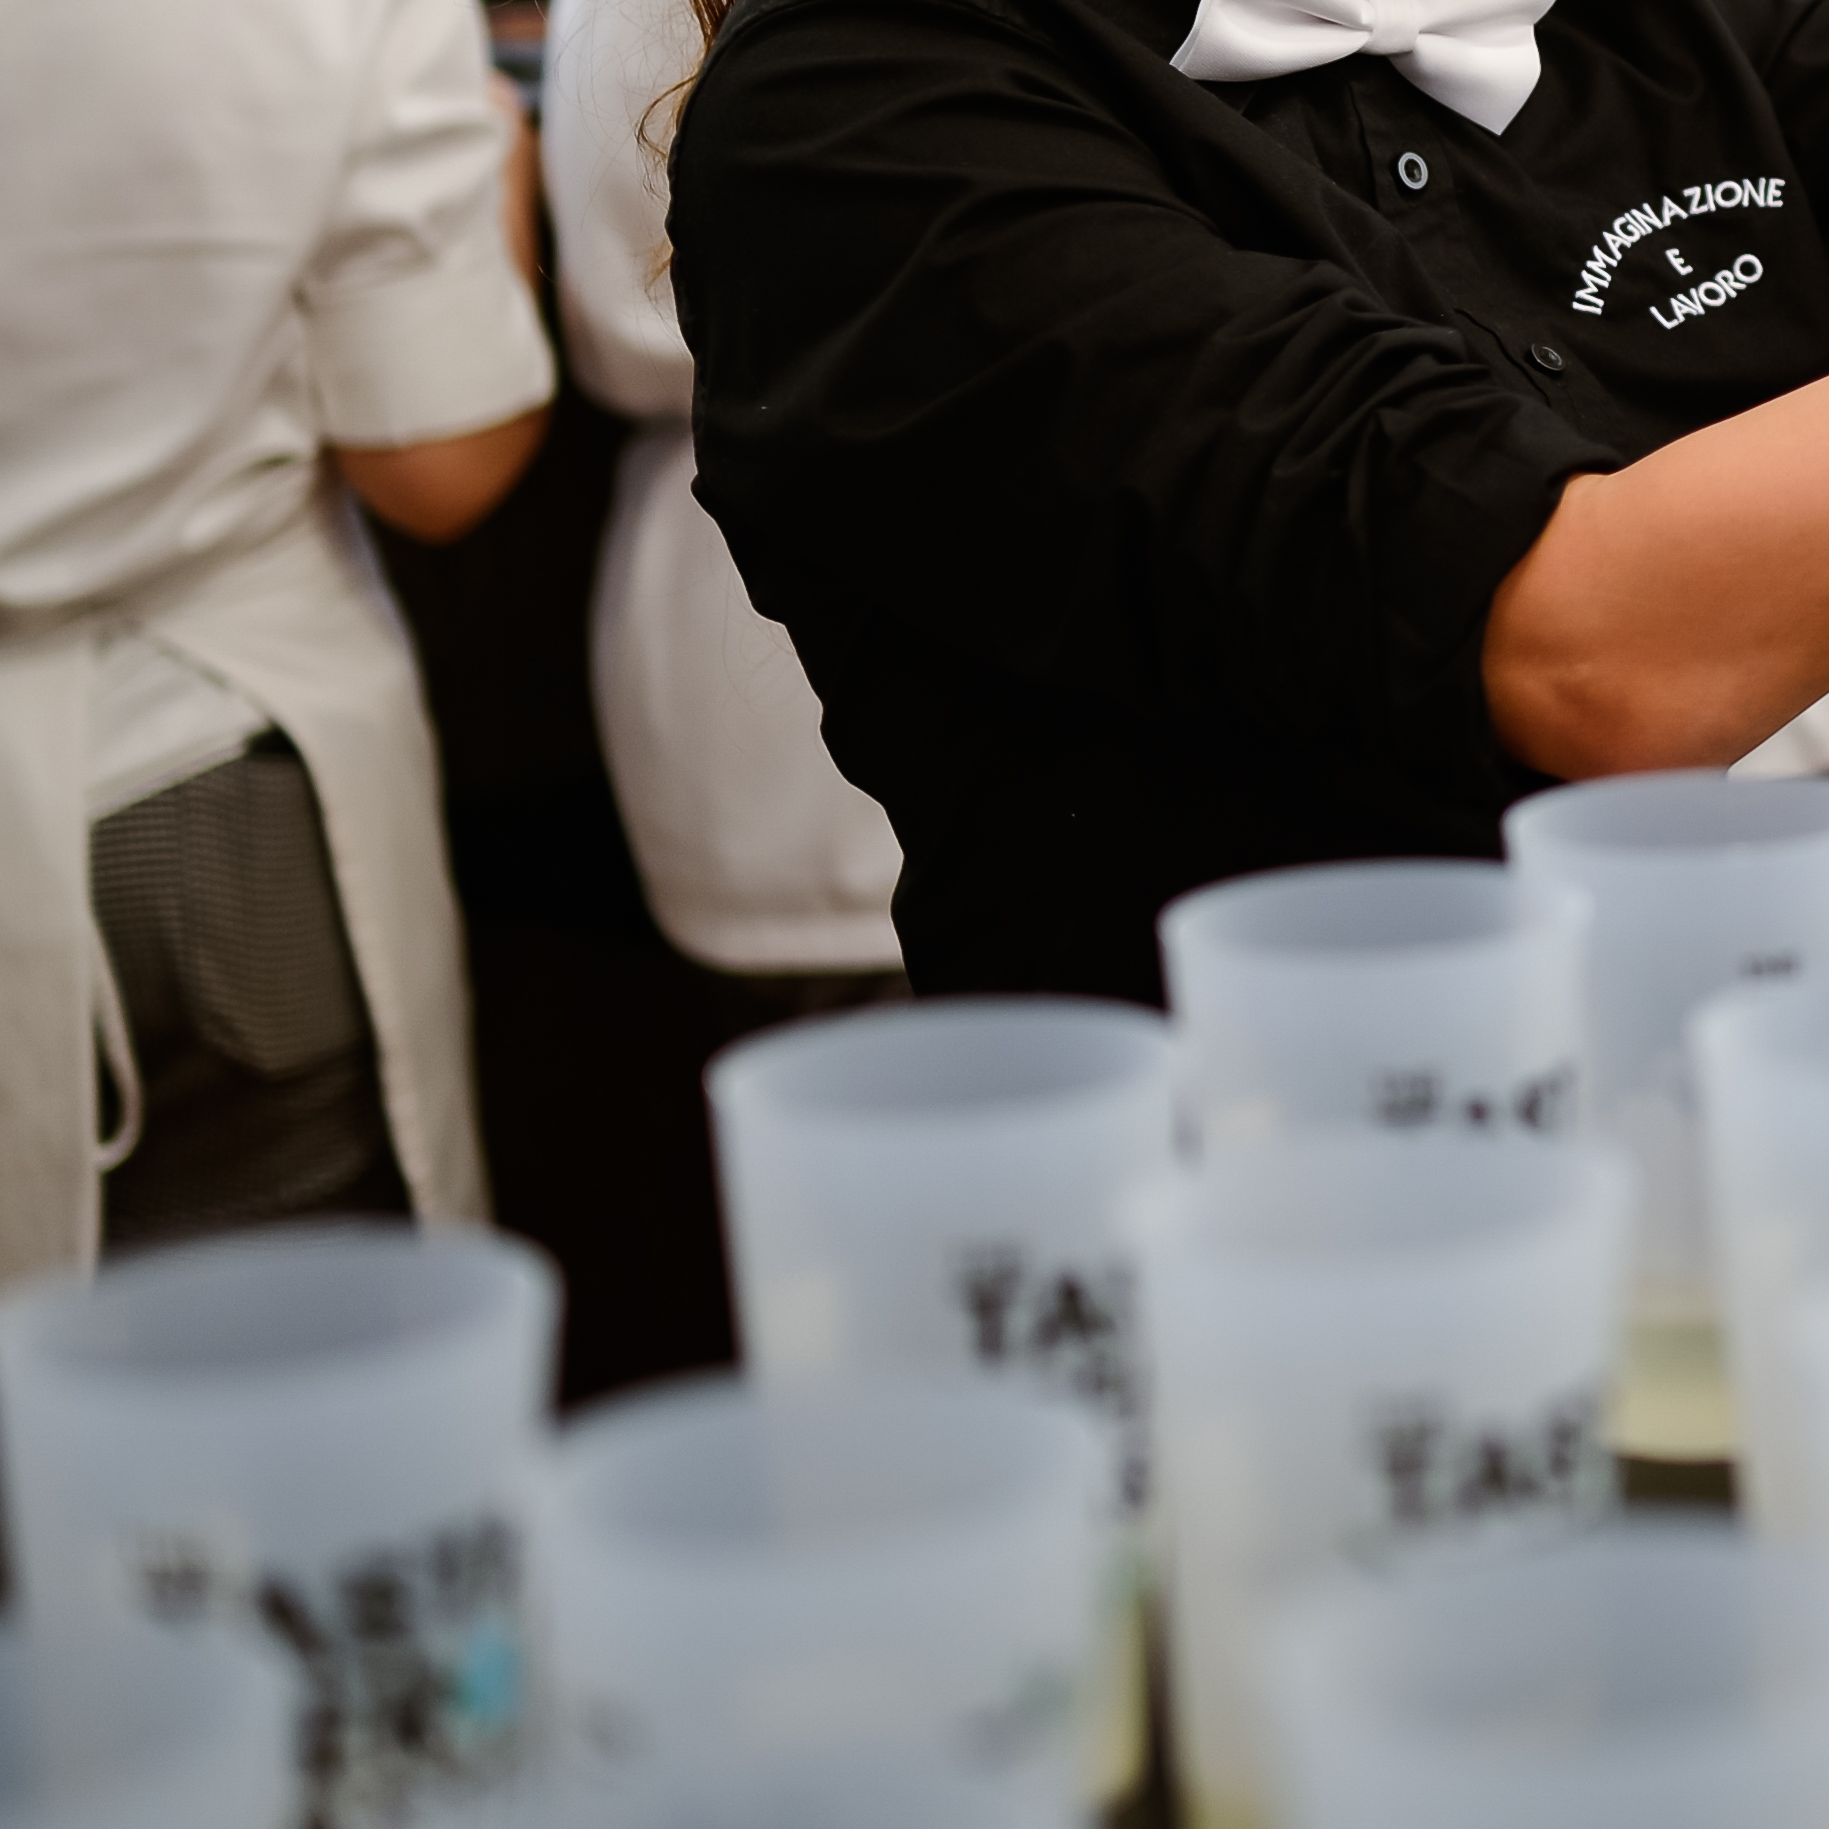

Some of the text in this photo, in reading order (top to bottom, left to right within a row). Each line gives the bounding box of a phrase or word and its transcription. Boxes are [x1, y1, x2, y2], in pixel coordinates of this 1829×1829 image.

[1572, 177, 1785, 315] IMMAGINAZIONE
[1665, 248, 1693, 275] E
[1650, 253, 1763, 329] LAVORO
